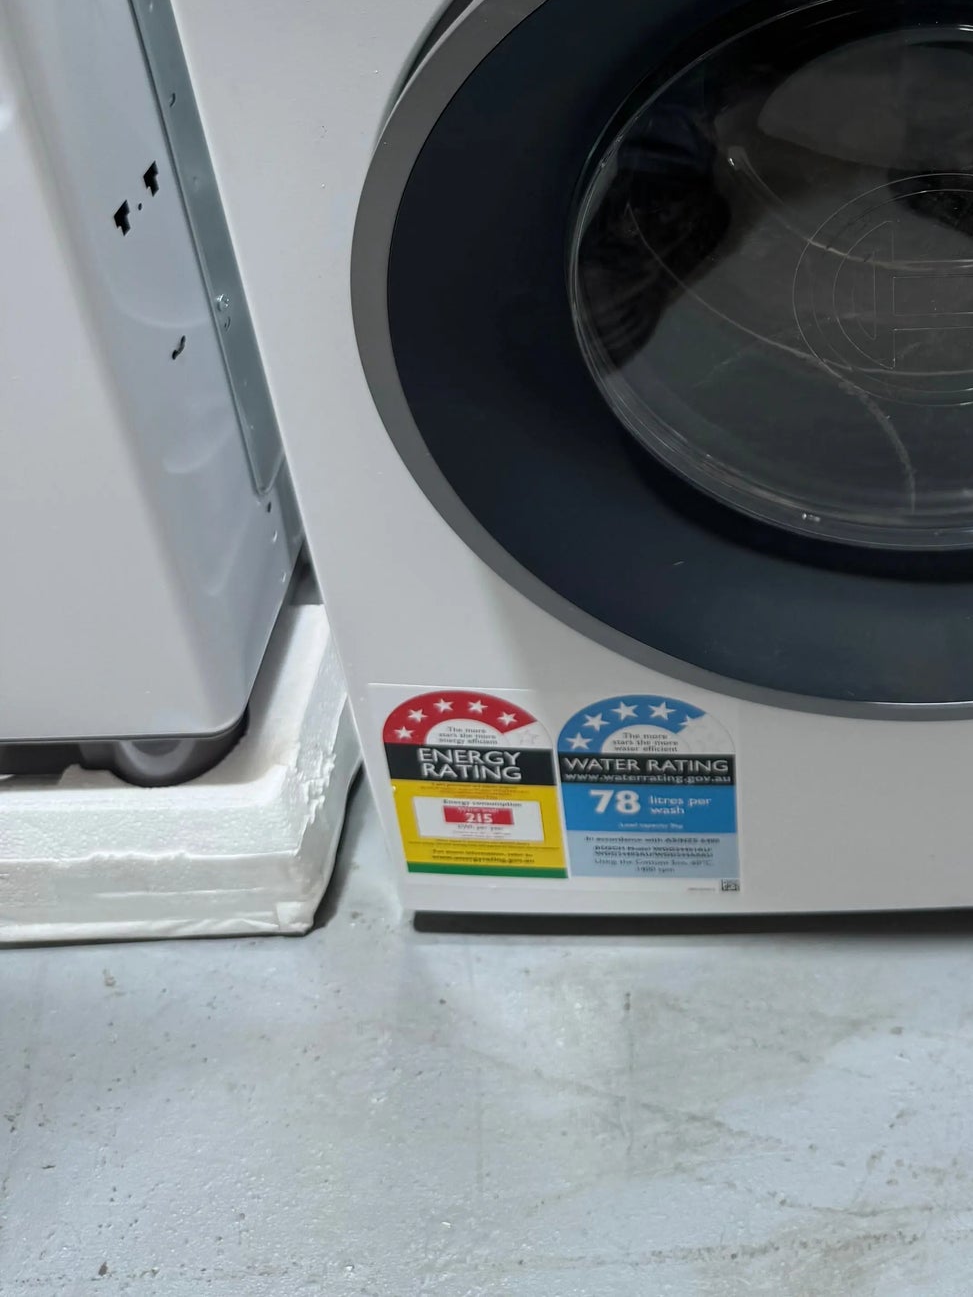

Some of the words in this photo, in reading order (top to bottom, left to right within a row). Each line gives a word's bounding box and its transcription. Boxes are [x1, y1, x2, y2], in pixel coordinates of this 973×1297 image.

[417, 748, 521, 765] ENERGY
[422, 763, 522, 780] RATING
[564, 757, 640, 772] WATER
[646, 759, 729, 773] RATING
[564, 773, 731, 785] www.waterrating.gov.au
[589, 789, 641, 814] 78
[648, 796, 683, 805] litres
[687, 798, 712, 807] per
[651, 806, 685, 814] wash
[465, 813, 493, 824] 215
